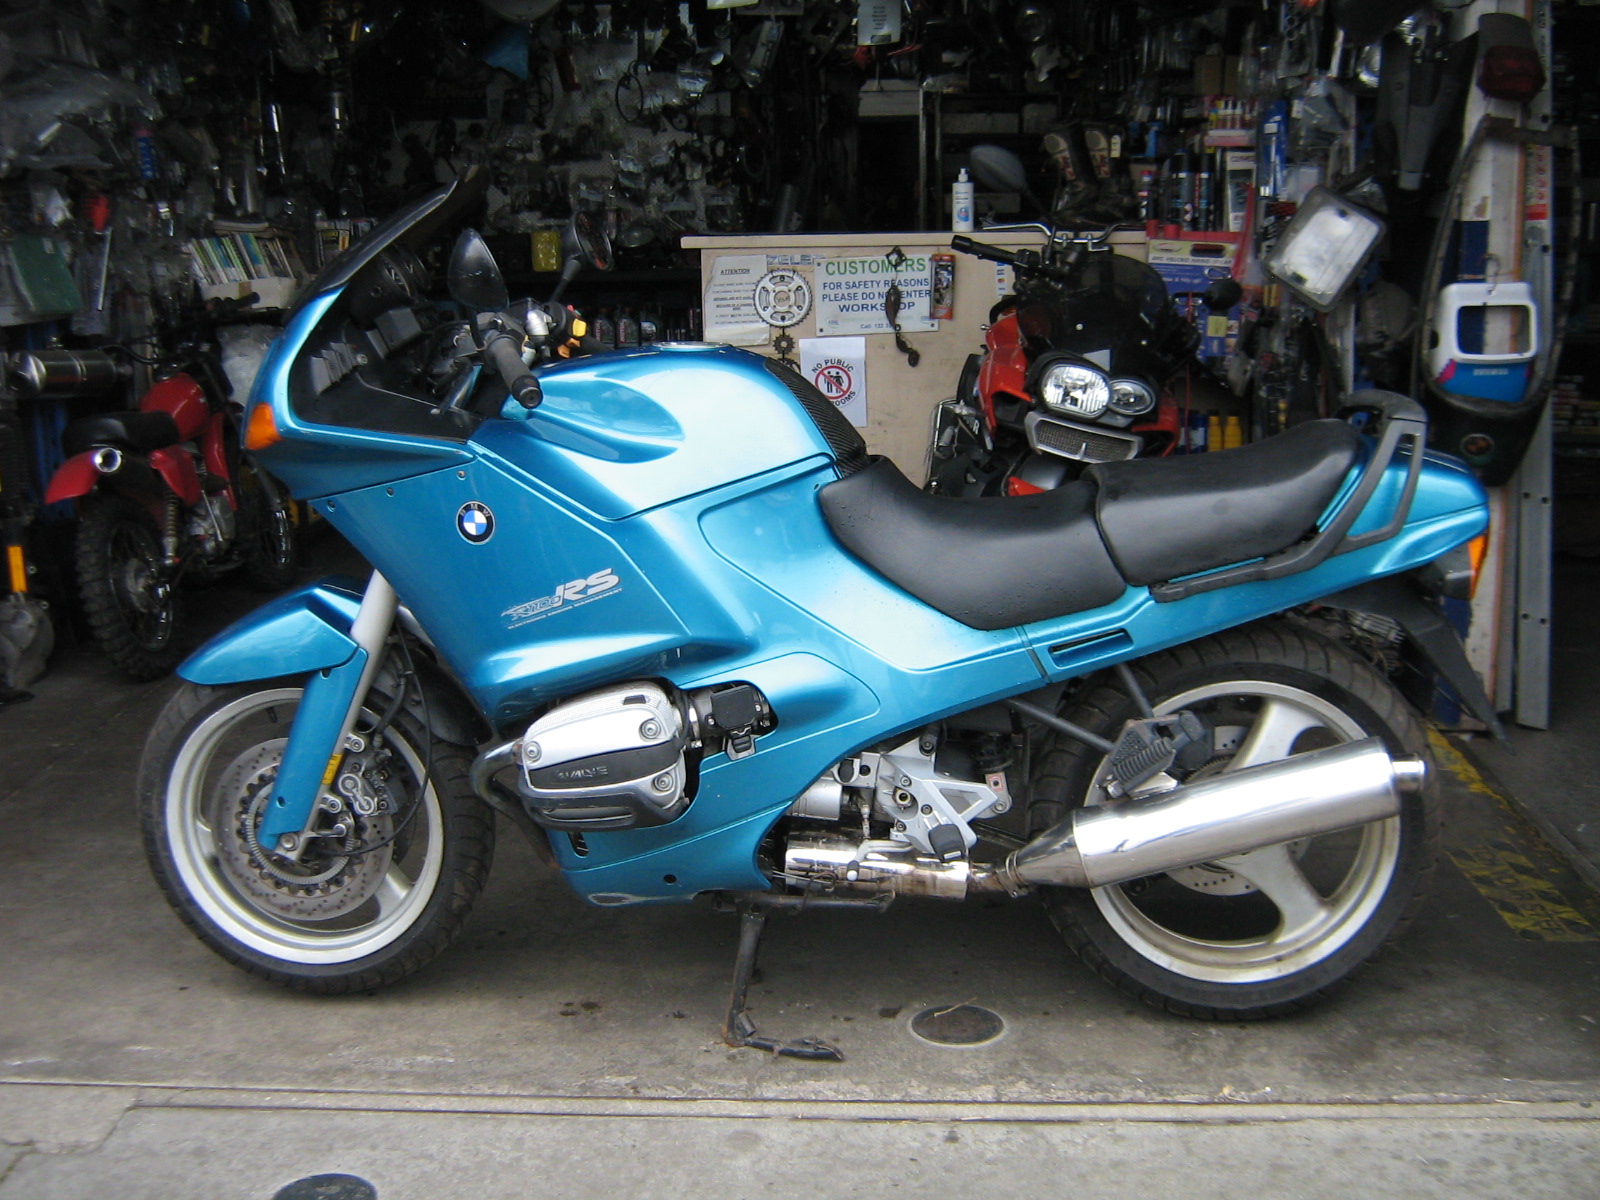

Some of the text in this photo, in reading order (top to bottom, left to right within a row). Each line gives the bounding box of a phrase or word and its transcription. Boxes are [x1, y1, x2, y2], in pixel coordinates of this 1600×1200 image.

[825, 257, 926, 276] CUSTOMERS
[823, 278, 929, 290] FOR SAFETY REASONS
[822, 292, 859, 302] PLEASE
[861, 291, 875, 300] DO
[901, 290, 931, 299] ENTER
[839, 302, 915, 312] WORKSOP
[811, 358, 854, 374] NO PUBLIC
[459, 503, 491, 516] BMW
